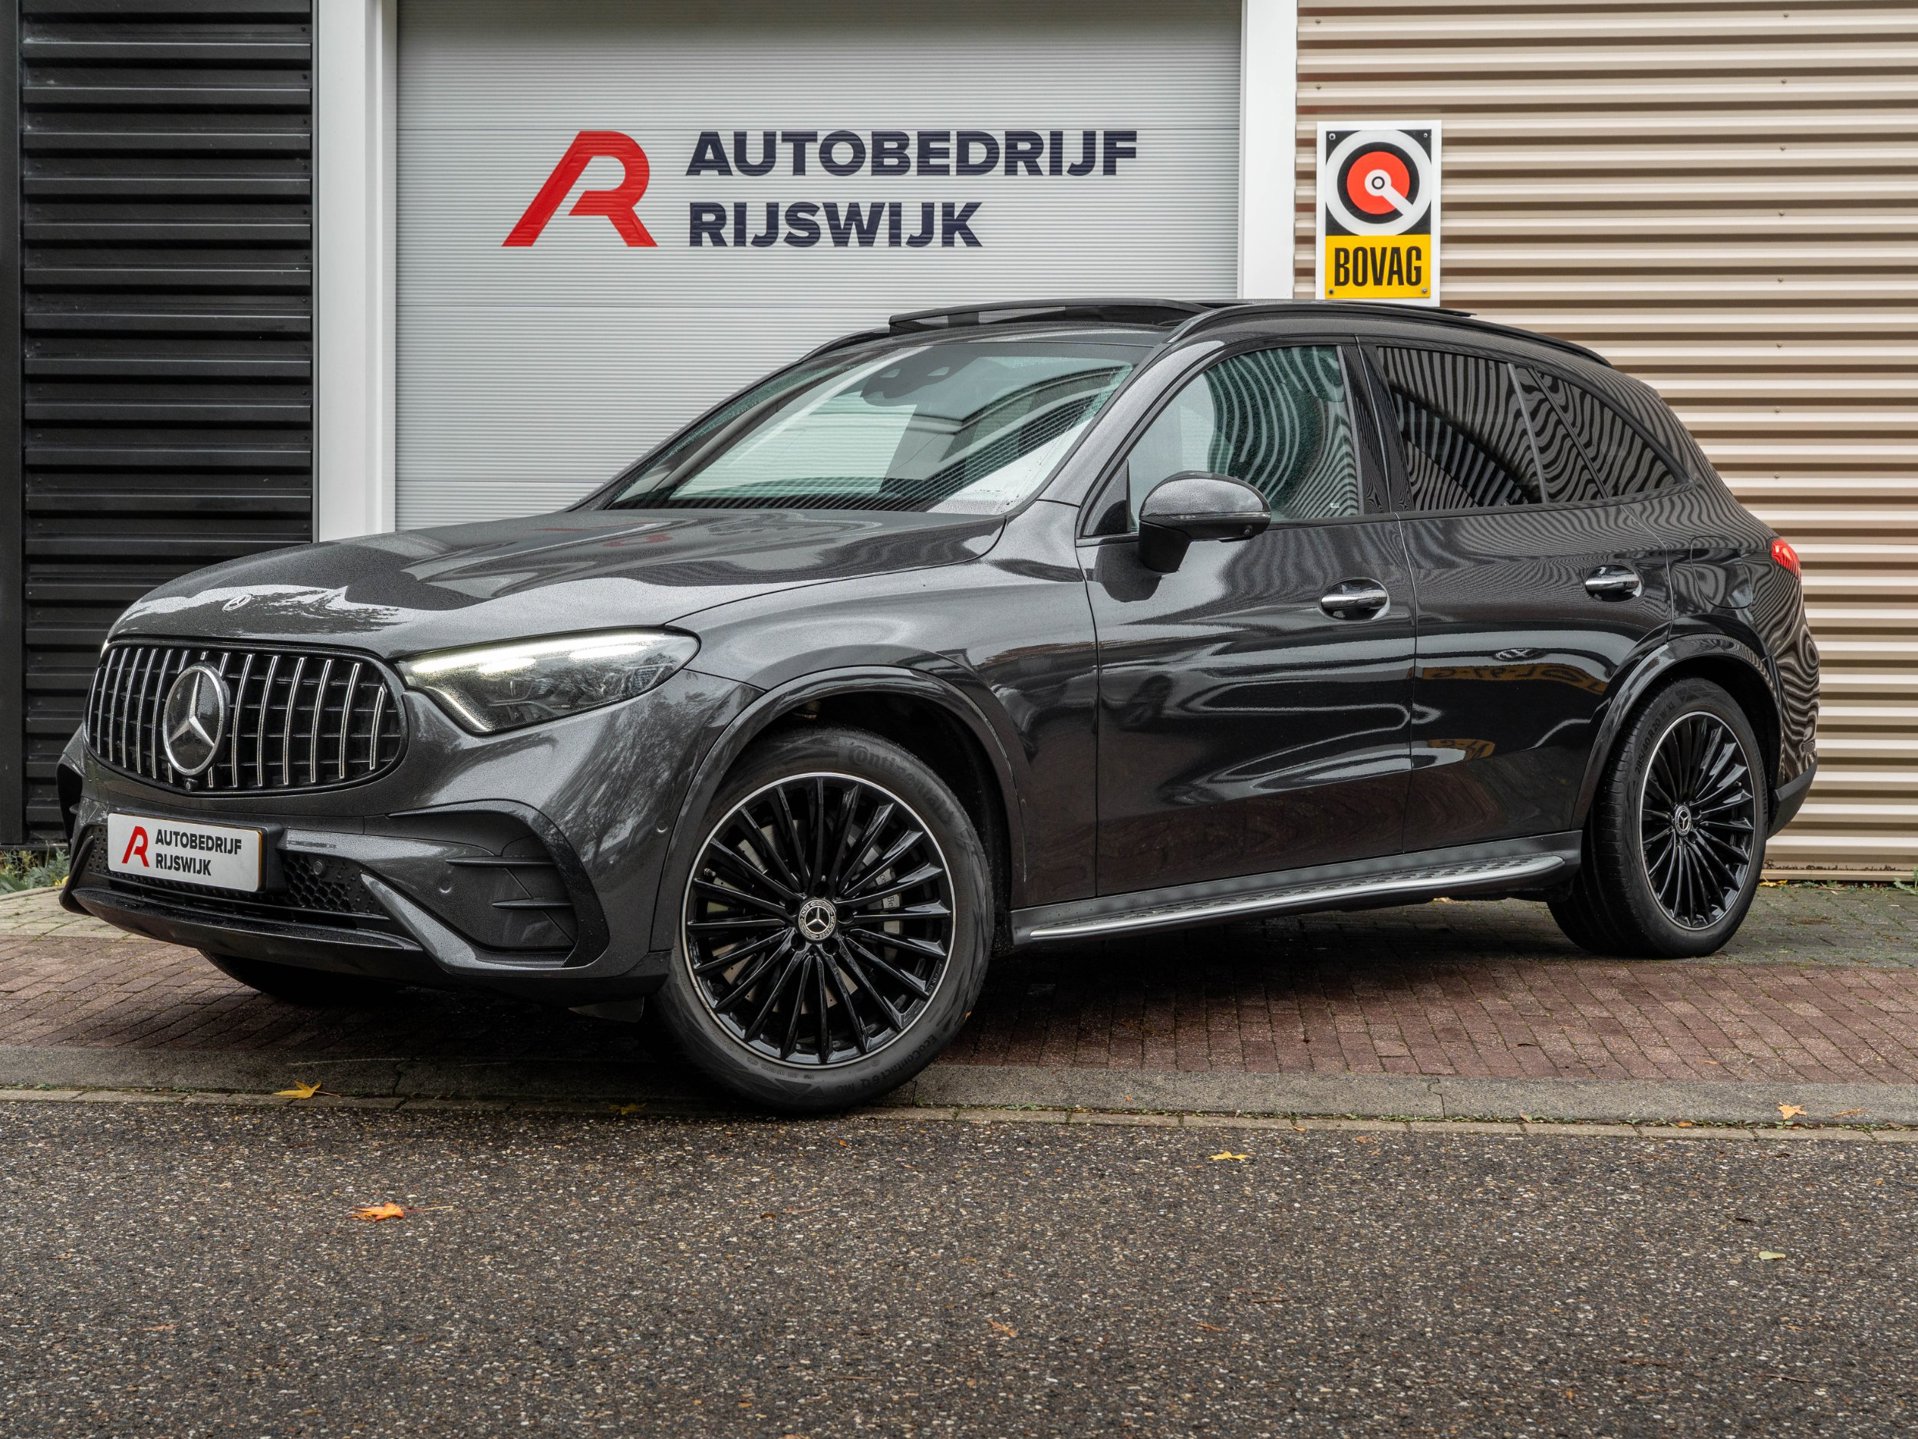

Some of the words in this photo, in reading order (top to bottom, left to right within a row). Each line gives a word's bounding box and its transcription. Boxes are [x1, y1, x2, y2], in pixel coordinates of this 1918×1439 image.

[686, 130, 1137, 176] AUTOBEDRIJF
[689, 202, 983, 247] RIJSWIJK
[1334, 246, 1422, 287] BOVAG
[155, 829, 242, 855] AUTOBEDRIJF
[155, 852, 211, 876] RIJSWIJK
